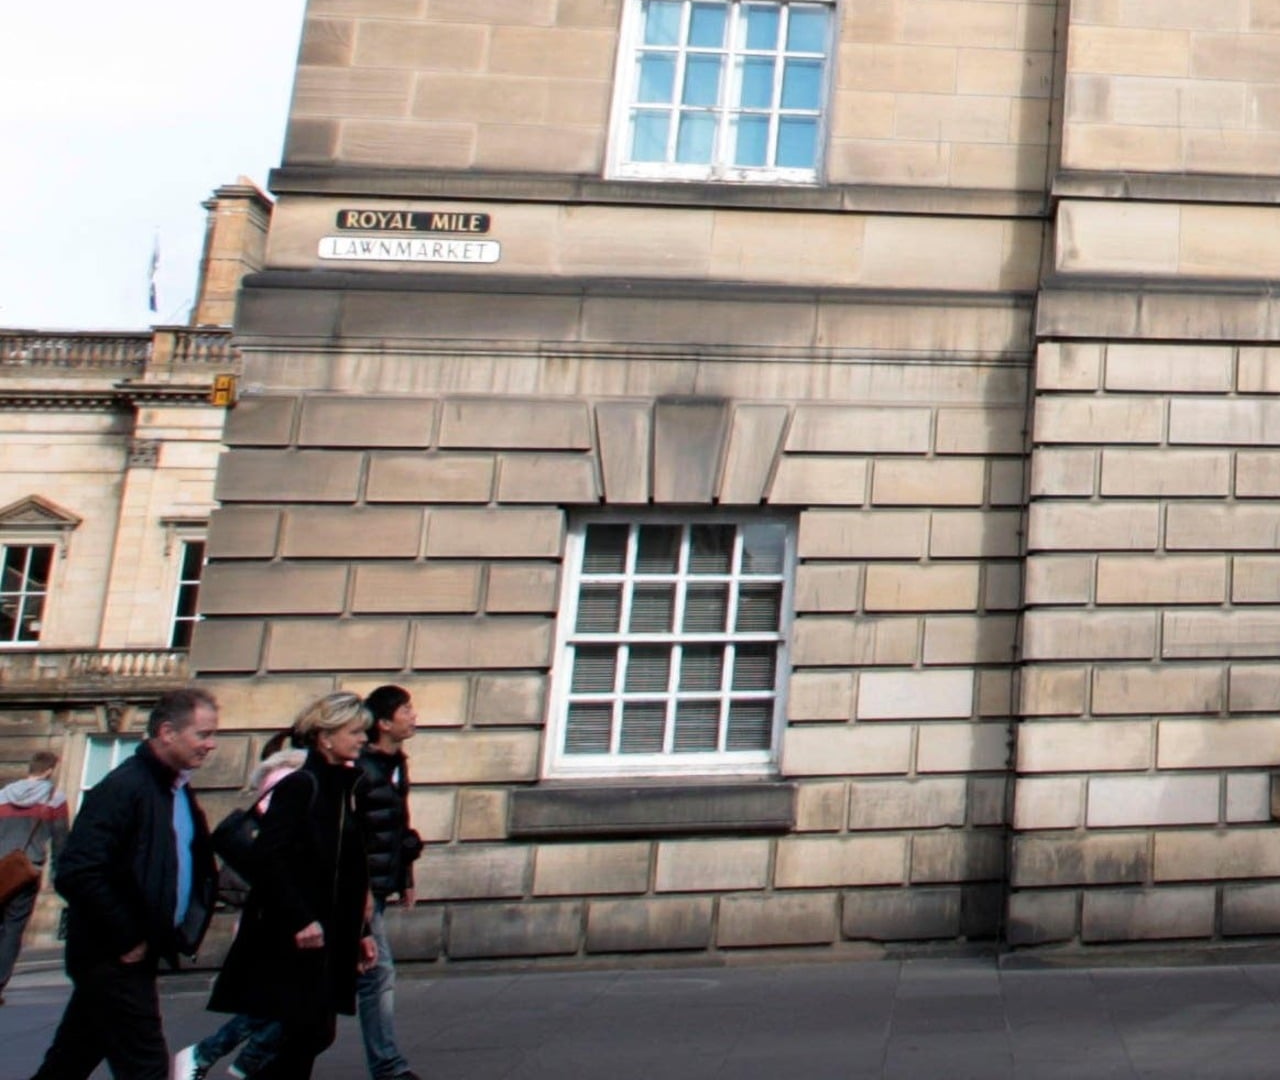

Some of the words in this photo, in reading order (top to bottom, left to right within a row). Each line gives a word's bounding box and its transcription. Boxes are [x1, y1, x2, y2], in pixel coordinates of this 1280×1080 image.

[346, 211, 417, 230] ROYAL
[430, 214, 482, 232] MILE
[332, 239, 488, 260] LAWNMARKET
